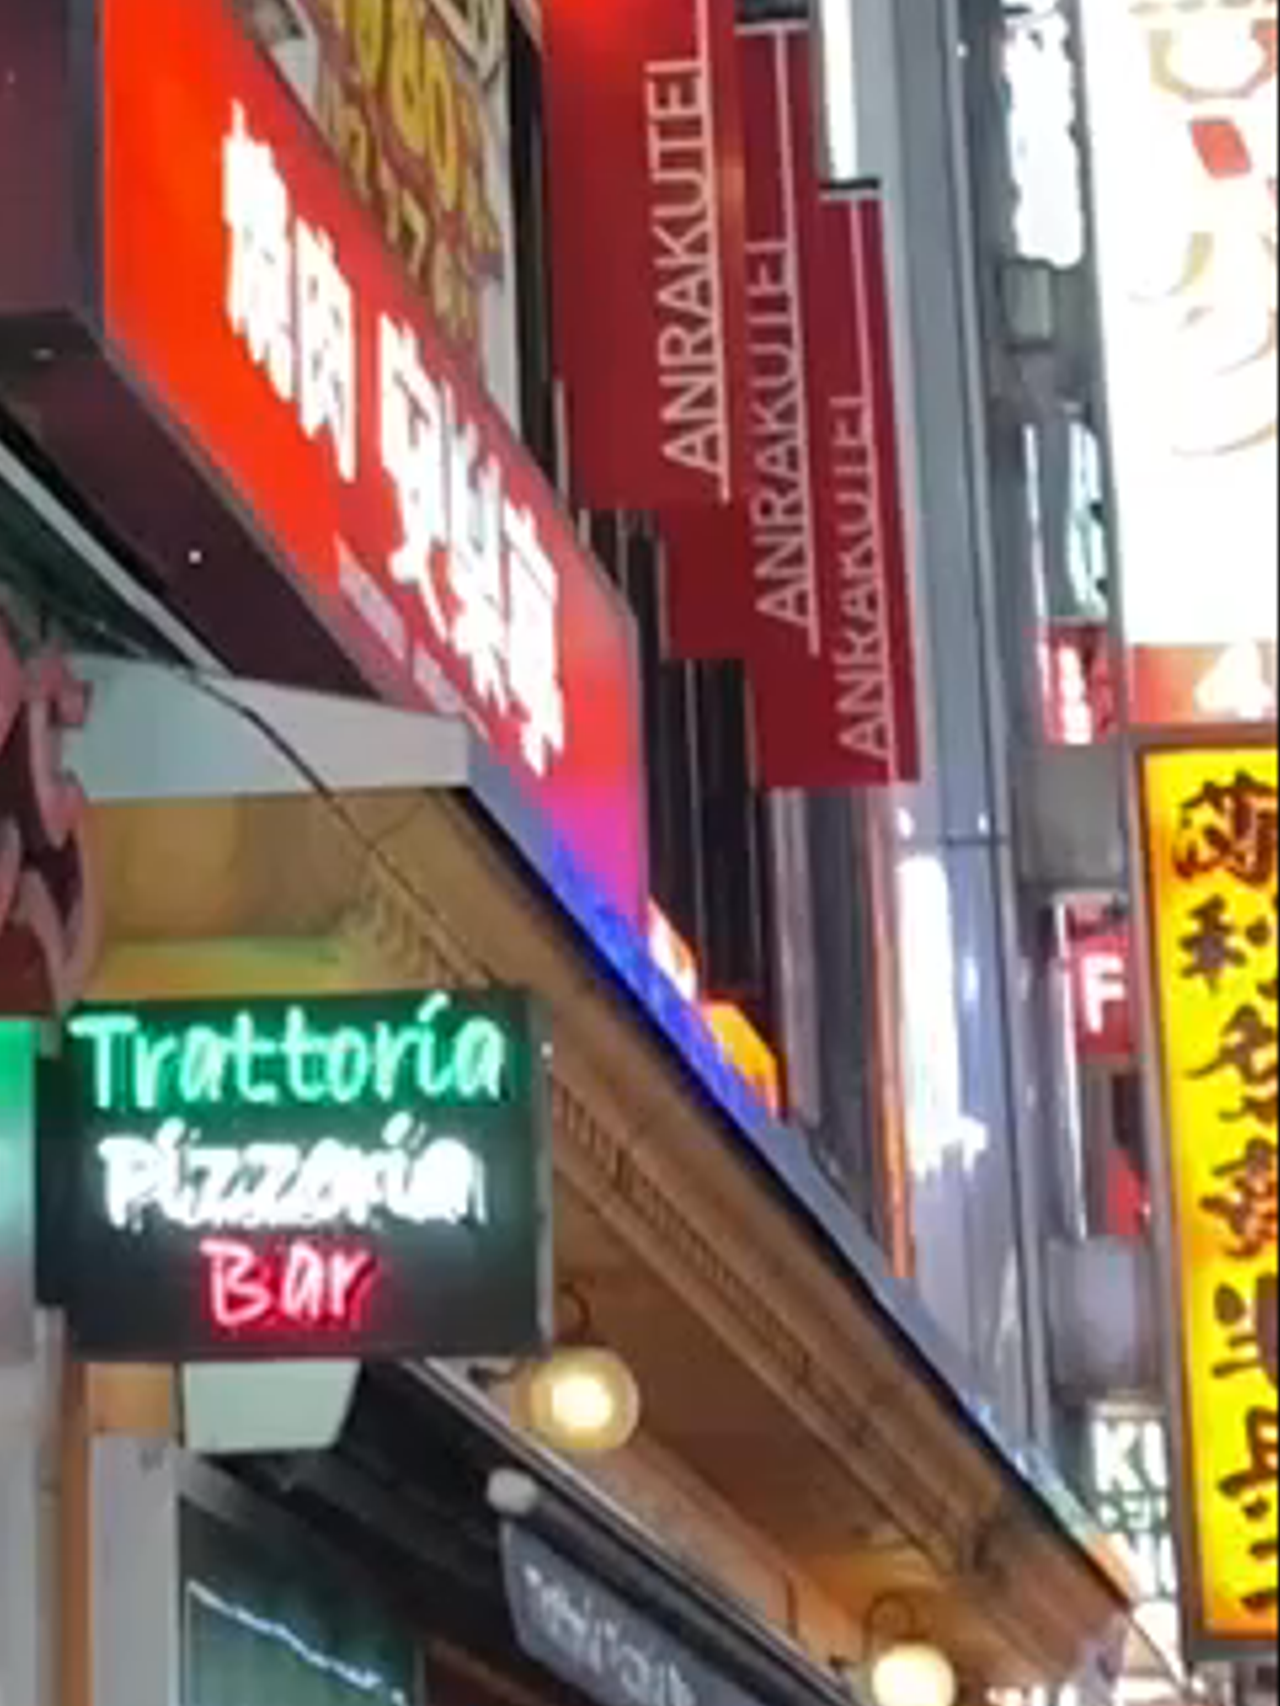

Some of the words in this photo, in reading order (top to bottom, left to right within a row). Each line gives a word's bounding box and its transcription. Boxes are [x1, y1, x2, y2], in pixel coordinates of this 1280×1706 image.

[647, 58, 726, 479] ANRAKUTEI
[747, 238, 815, 626] ANRAKUTEI
[832, 392, 890, 758] ANRAKUTEI
[68, 990, 506, 1110] Trattoria
[200, 1238, 378, 1330] Bar
